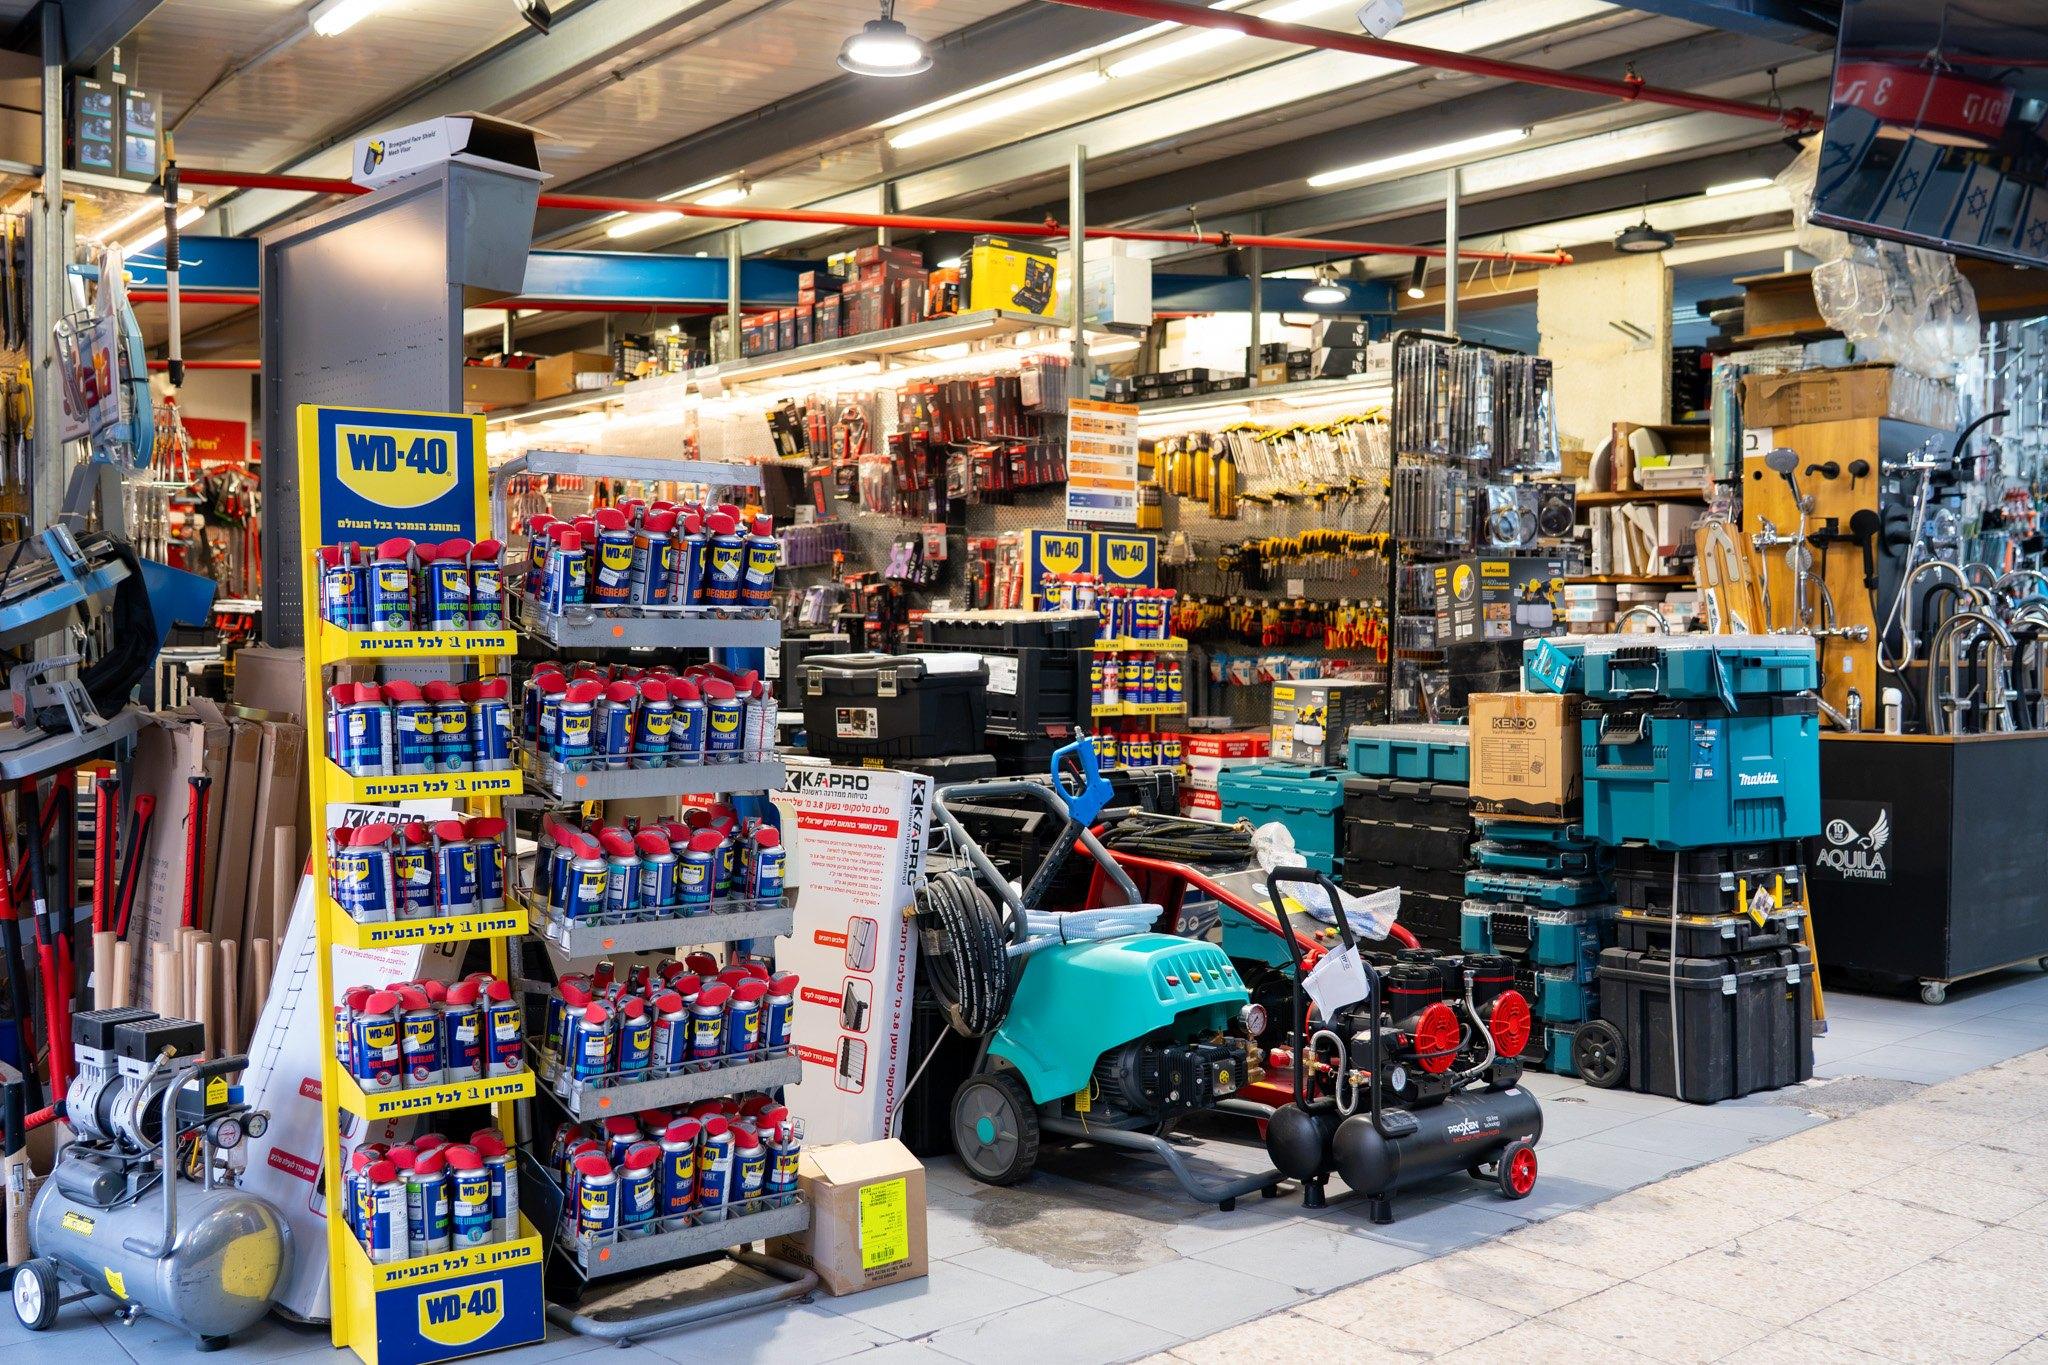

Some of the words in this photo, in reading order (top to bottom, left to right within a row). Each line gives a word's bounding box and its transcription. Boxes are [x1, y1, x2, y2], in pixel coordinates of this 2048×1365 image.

[346, 433, 448, 475] WD-40
[337, 518, 372, 529] העולם
[373, 518, 393, 530] בכל
[394, 522, 426, 531] הנמכר
[428, 523, 461, 532] המותג
[1045, 540, 1079, 558] WD-40
[1111, 544, 1144, 562] WD-40
[360, 639, 413, 649] הבעיות
[418, 636, 443, 648] לכל
[466, 637, 505, 650] פתרון
[566, 718, 589, 729] WD-40
[714, 713, 737, 724] WD-40
[1492, 717, 1537, 729] KENDO
[422, 779, 449, 792] לכל
[471, 779, 511, 791] פתרון
[802, 772, 869, 790] KAPRO
[365, 783, 419, 795] הבעיות
[847, 791, 868, 800] בטיחות
[813, 800, 824, 809] 3.8
[824, 801, 841, 812] נשען
[842, 803, 871, 813] טלסקופי
[872, 804, 890, 815] סולם
[1833, 823, 1844, 833] 10
[1816, 848, 1886, 871] AQUILA
[1843, 868, 1886, 879] premium
[428, 922, 454, 935] לכל
[477, 919, 517, 932] פתרון
[371, 928, 425, 941] הבעיות
[368, 1026, 394, 1040] WD-40
[406, 1023, 432, 1034] WD-40
[484, 1081, 524, 1099] פתרון
[436, 1090, 462, 1104] לכל
[378, 1096, 432, 1113] הבעיות
[462, 1184, 487, 1196] WD-40
[491, 1247, 531, 1264] פתרון
[443, 1256, 468, 1272] לכל
[385, 1264, 439, 1281] הבעיות
[426, 1287, 498, 1325] WD-40
